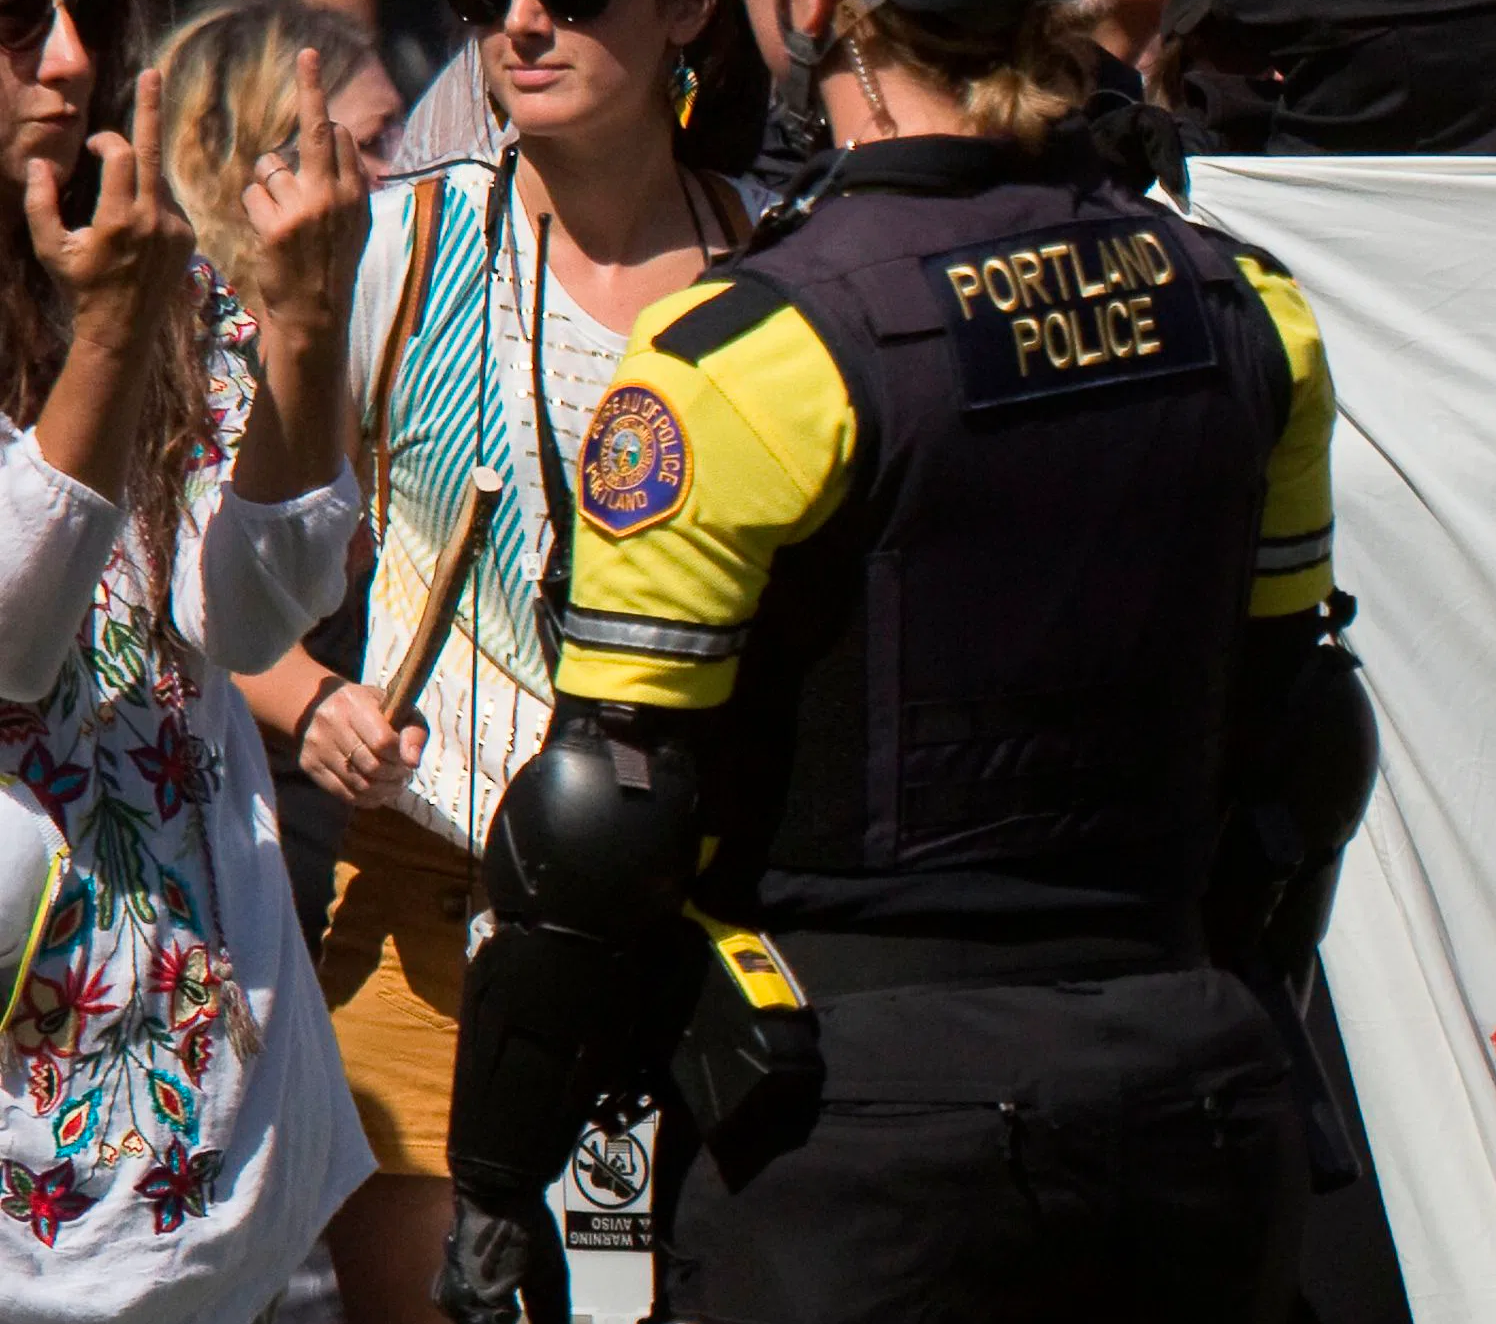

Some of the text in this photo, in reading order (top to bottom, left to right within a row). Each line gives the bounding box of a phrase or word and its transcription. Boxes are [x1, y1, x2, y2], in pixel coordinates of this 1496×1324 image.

[946, 232, 1177, 320] PORTLAND
[1011, 296, 1162, 377] POLICE
[641, 397, 662, 420] OF
[653, 415, 681, 488] POLICE
[570, 1231, 634, 1247] WARNING
[591, 1217, 633, 1231] AVISO
